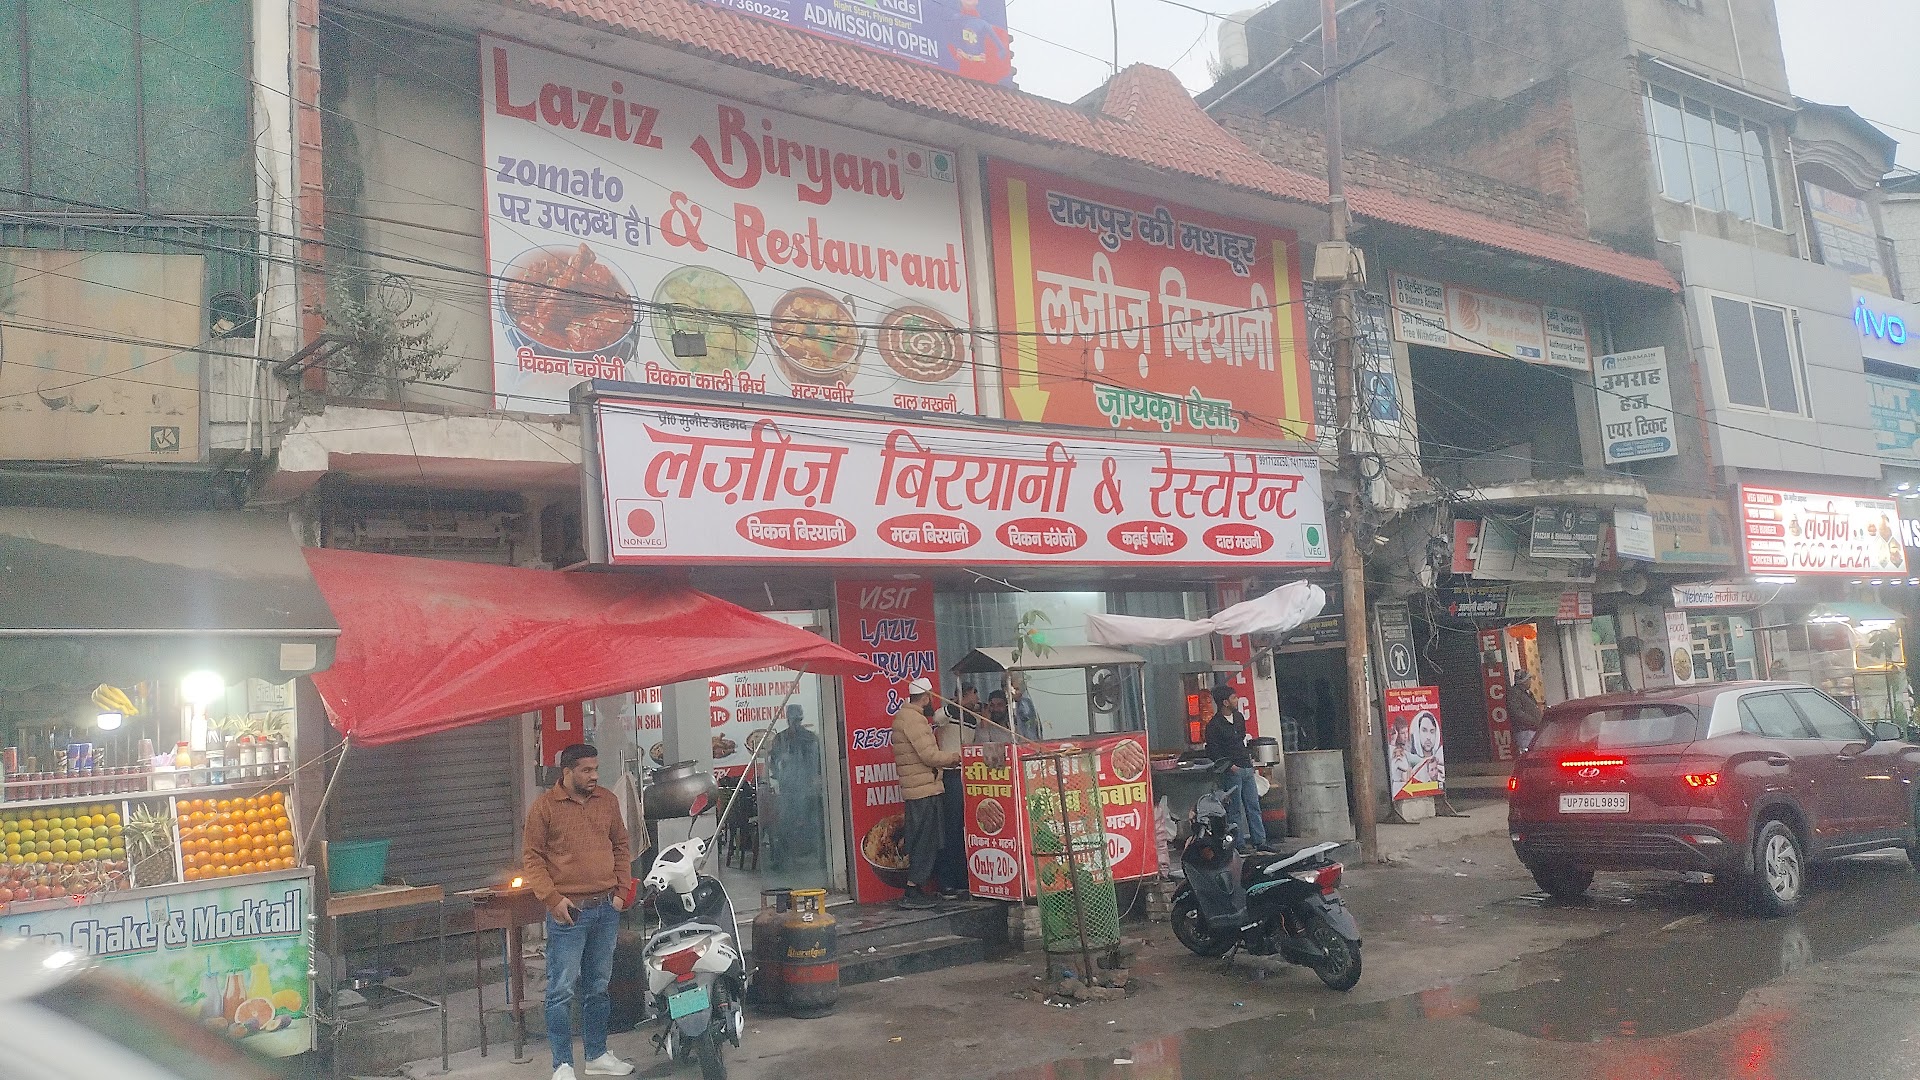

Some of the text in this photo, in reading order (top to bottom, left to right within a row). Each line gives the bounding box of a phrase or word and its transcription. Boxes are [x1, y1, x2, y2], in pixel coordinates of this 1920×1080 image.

[804, 3, 894, 46] ADMISSION
[897, 30, 939, 59] OPEN
[493, 46, 906, 204] Laziz Biryani
[497, 156, 624, 203] zomato
[498, 193, 532, 226] पर
[536, 200, 618, 240] उपलब्ध
[659, 191, 961, 294] & Restaurant
[1047, 191, 1257, 277] रामपुर की मशहूर
[1037, 251, 1274, 378] लज़ीज़ बिरयानी
[517, 348, 570, 376] चिकन
[645, 361, 766, 394] चिकन काली मिर्च
[1601, 368, 1661, 391] उमराह
[791, 379, 854, 404] मटर पनीर
[893, 393, 958, 413] दाल मखनी
[1606, 415, 1667, 440] एयर टिकट
[643, 418, 849, 508] लज़ीज़
[875, 428, 1077, 512] बिरयानी
[1093, 456, 1125, 516] &
[622, 537, 663, 547] NON-VEG
[747, 517, 847, 543] चिकन बिरयानी
[890, 523, 969, 545] मटन बिरयानी
[1008, 524, 1042, 547] चिकन
[1149, 528, 1174, 548] पनीर
[1215, 531, 1262, 550] दाल मखनी
[1308, 547, 1322, 556] VEG
[860, 587, 917, 610] VISIT
[860, 618, 919, 648] LAZIZ
[735, 682, 767, 698] KADHAI
[736, 707, 772, 722] CHICKEN
[965, 783, 1013, 798] कबाब
[1567, 797, 1625, 808] UP78GL9899
[974, 854, 994, 881] Only
[70, 916, 158, 956] Shake
[164, 910, 187, 948] &
[191, 889, 302, 943] Mocktail
